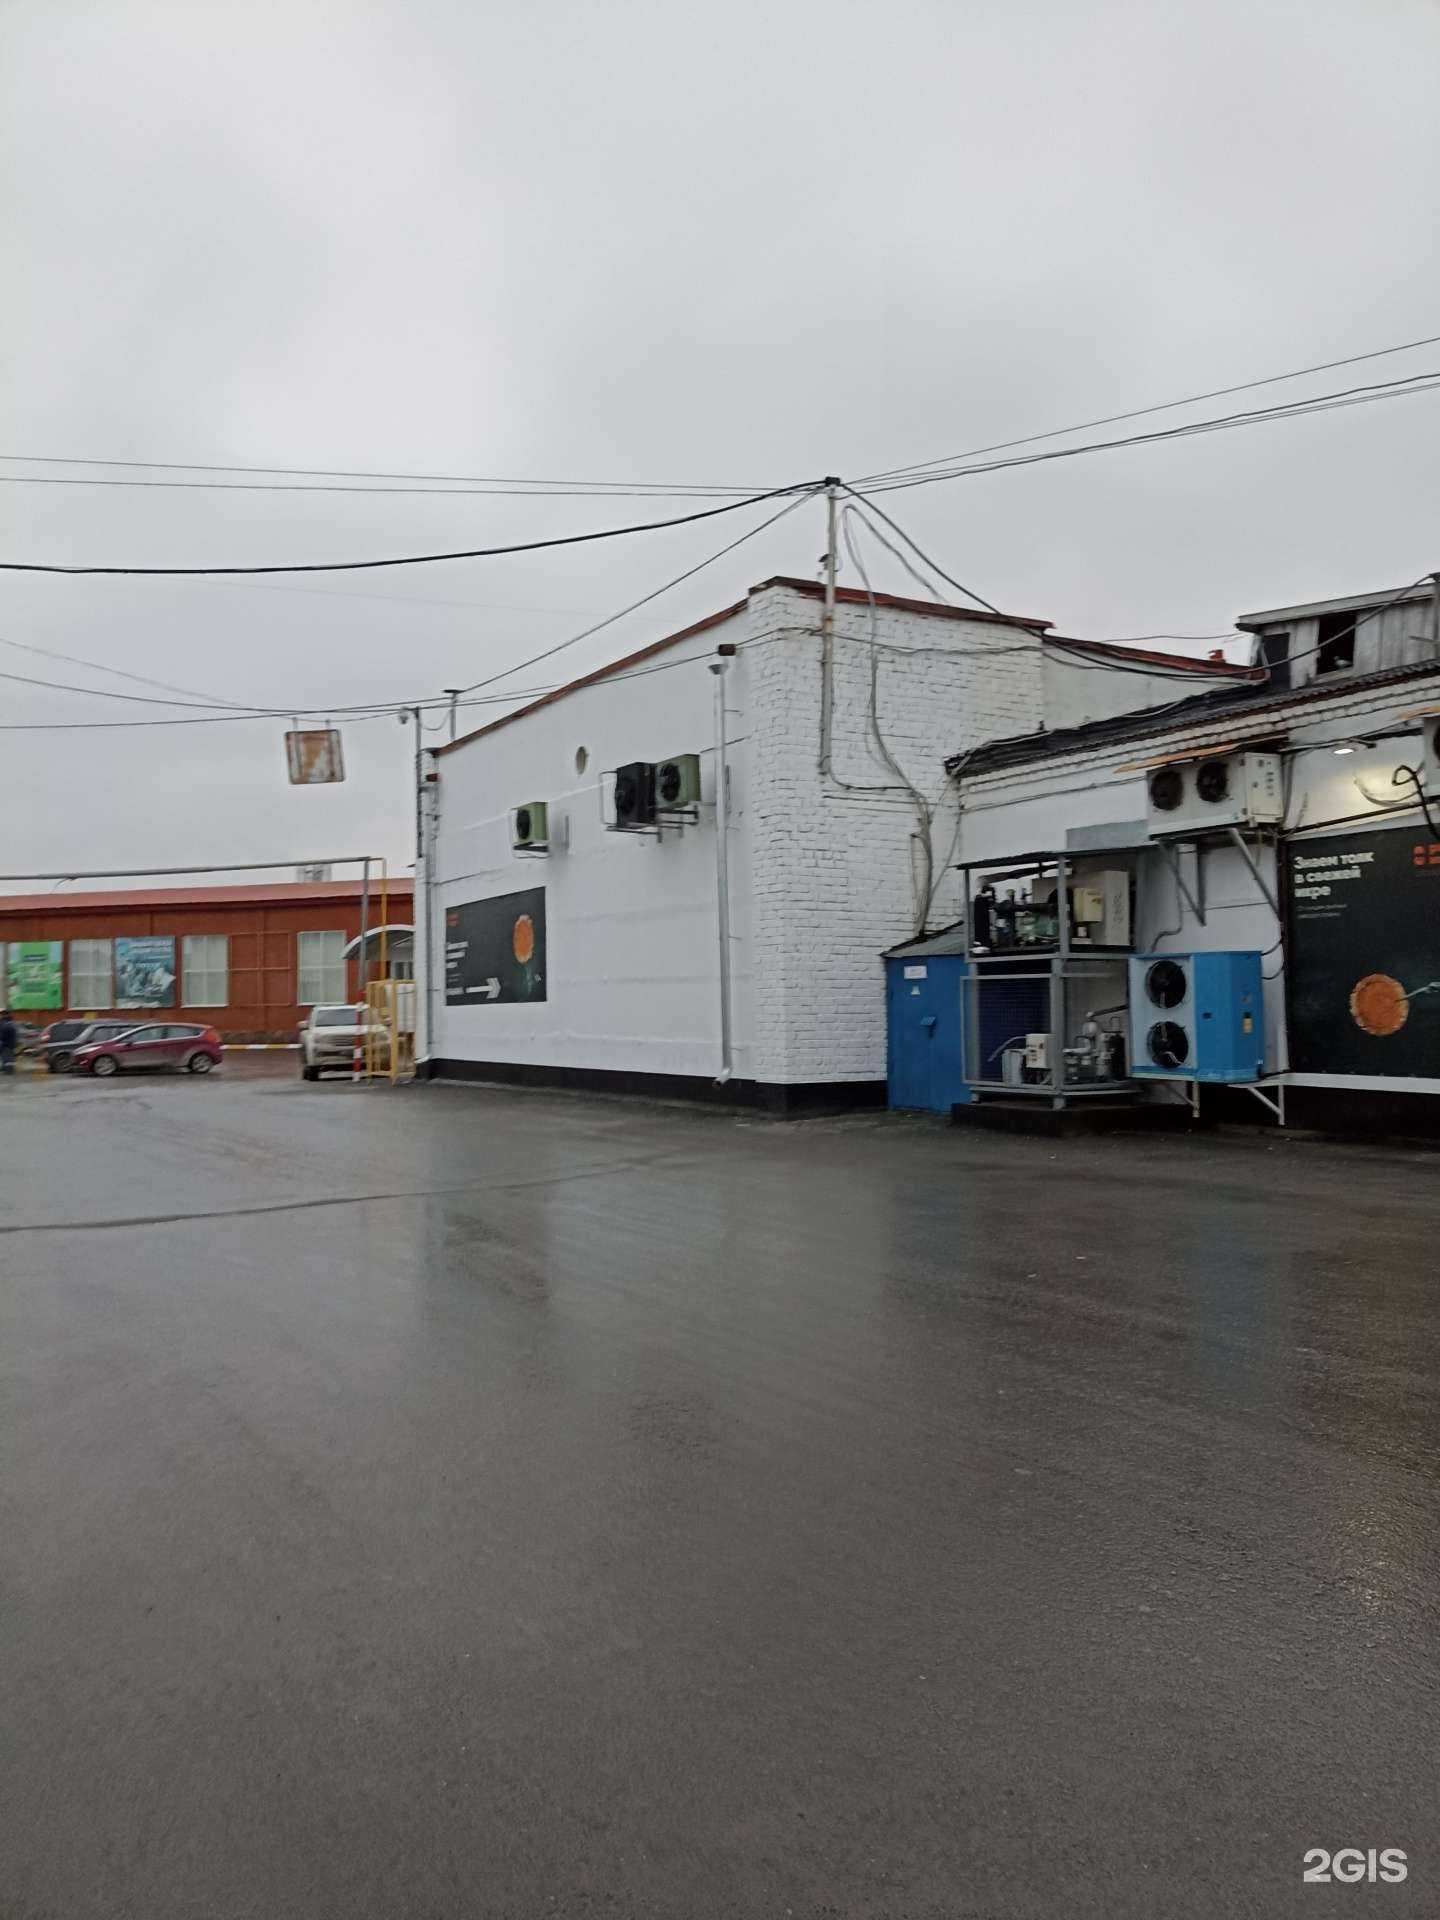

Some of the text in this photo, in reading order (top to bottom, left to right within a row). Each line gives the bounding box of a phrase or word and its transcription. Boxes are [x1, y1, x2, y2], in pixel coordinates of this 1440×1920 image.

[1340, 852, 1374, 864] толк
[1294, 874, 1305, 883] в
[1294, 886, 1331, 900] икре
